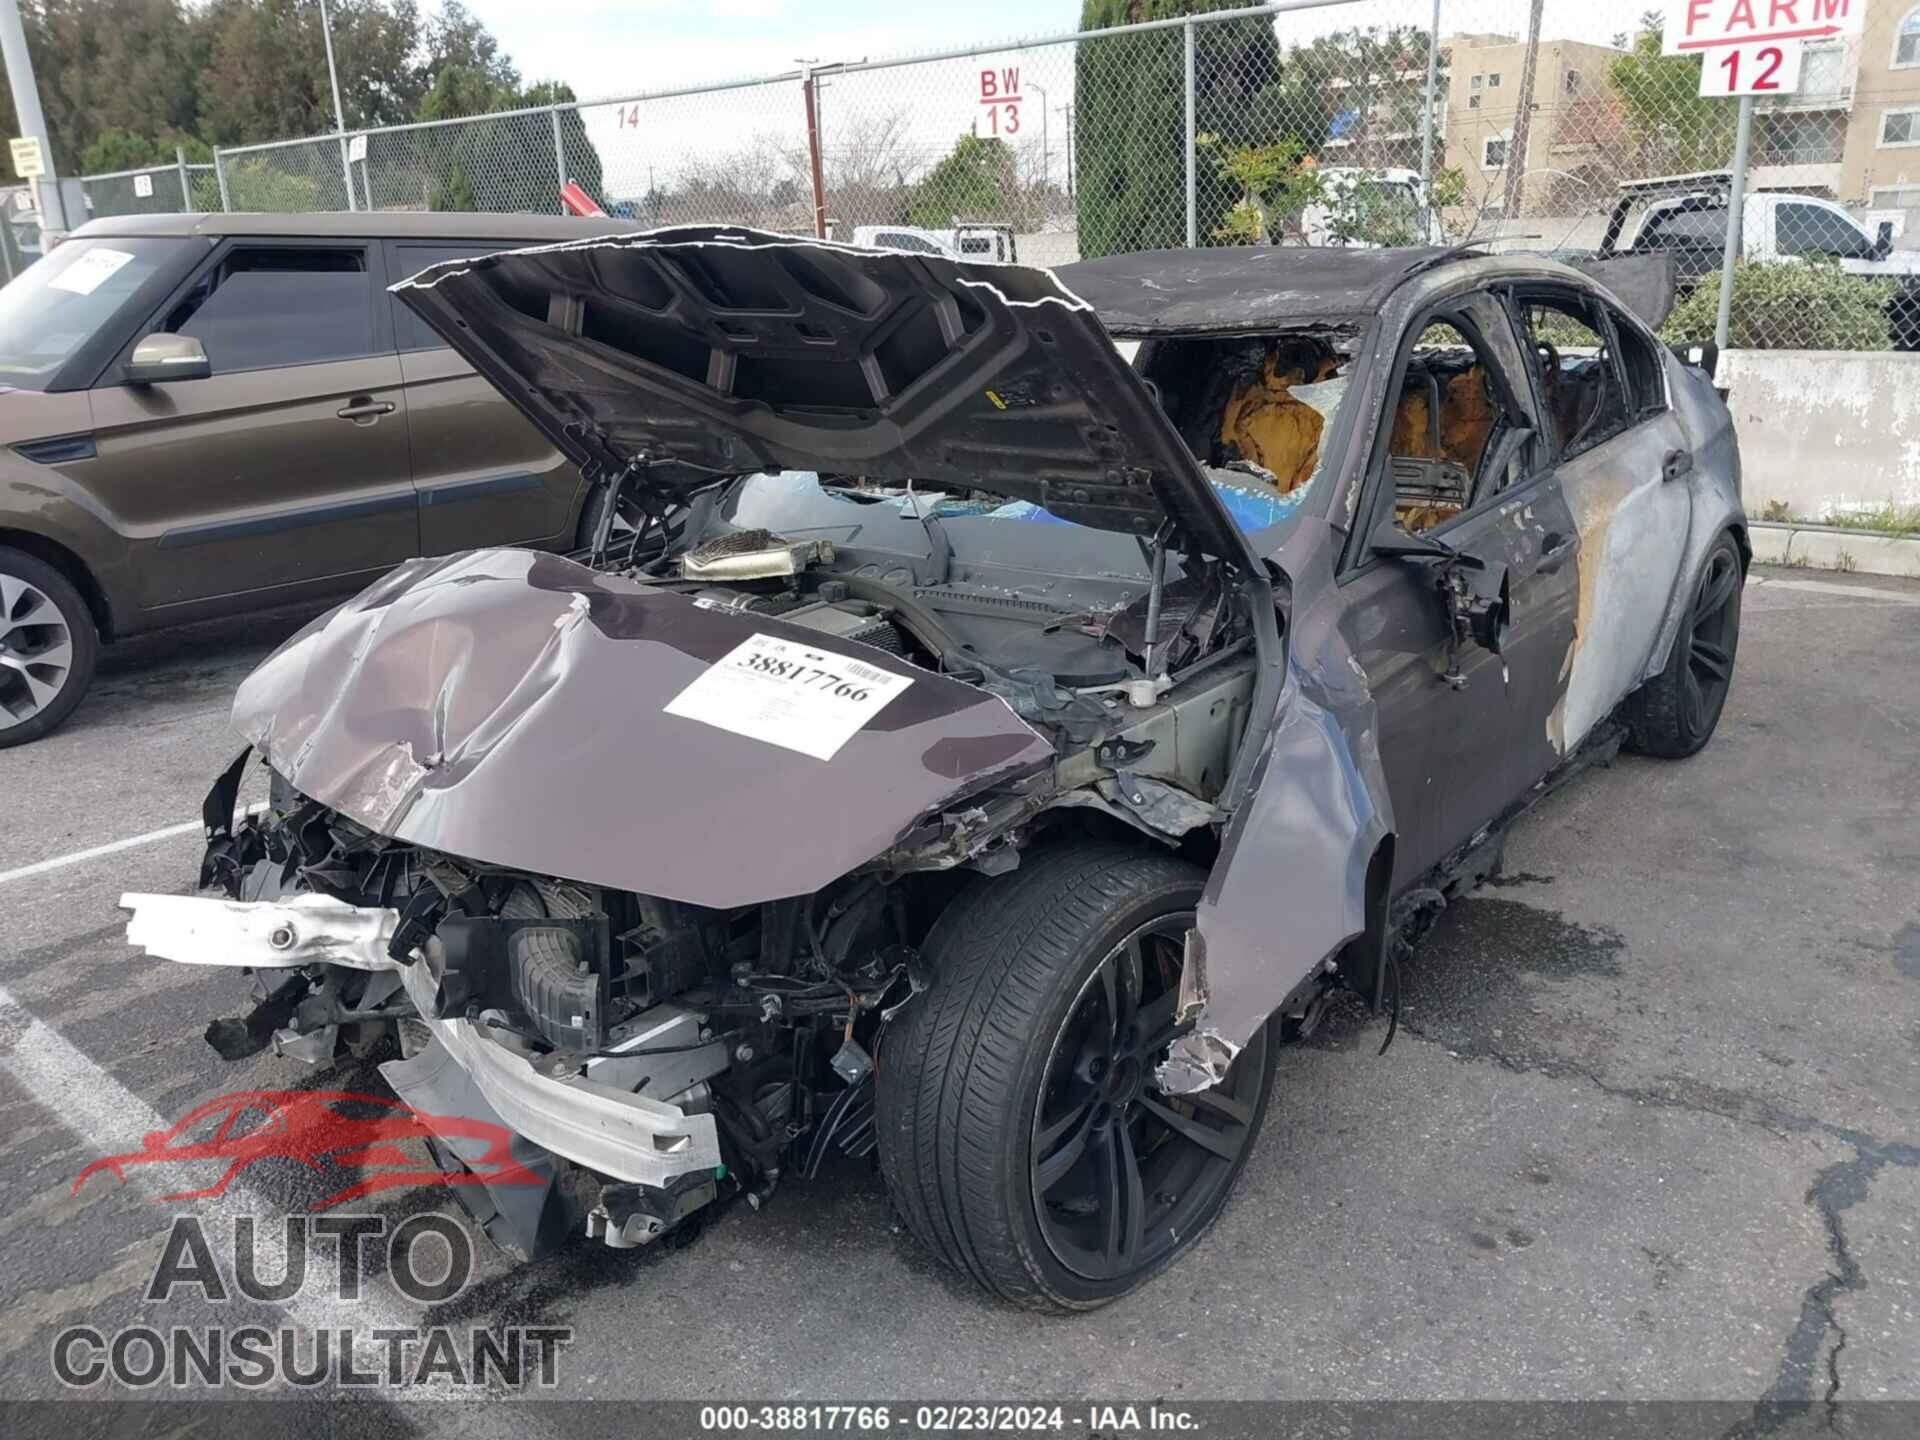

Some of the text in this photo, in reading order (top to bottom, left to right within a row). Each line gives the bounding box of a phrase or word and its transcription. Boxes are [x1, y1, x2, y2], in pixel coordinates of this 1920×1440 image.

[981, 66, 1020, 97] BW
[1720, 47, 1783, 92] 12
[617, 104, 639, 129] 14
[987, 104, 1020, 135] 13
[737, 653, 876, 701] 38817766
